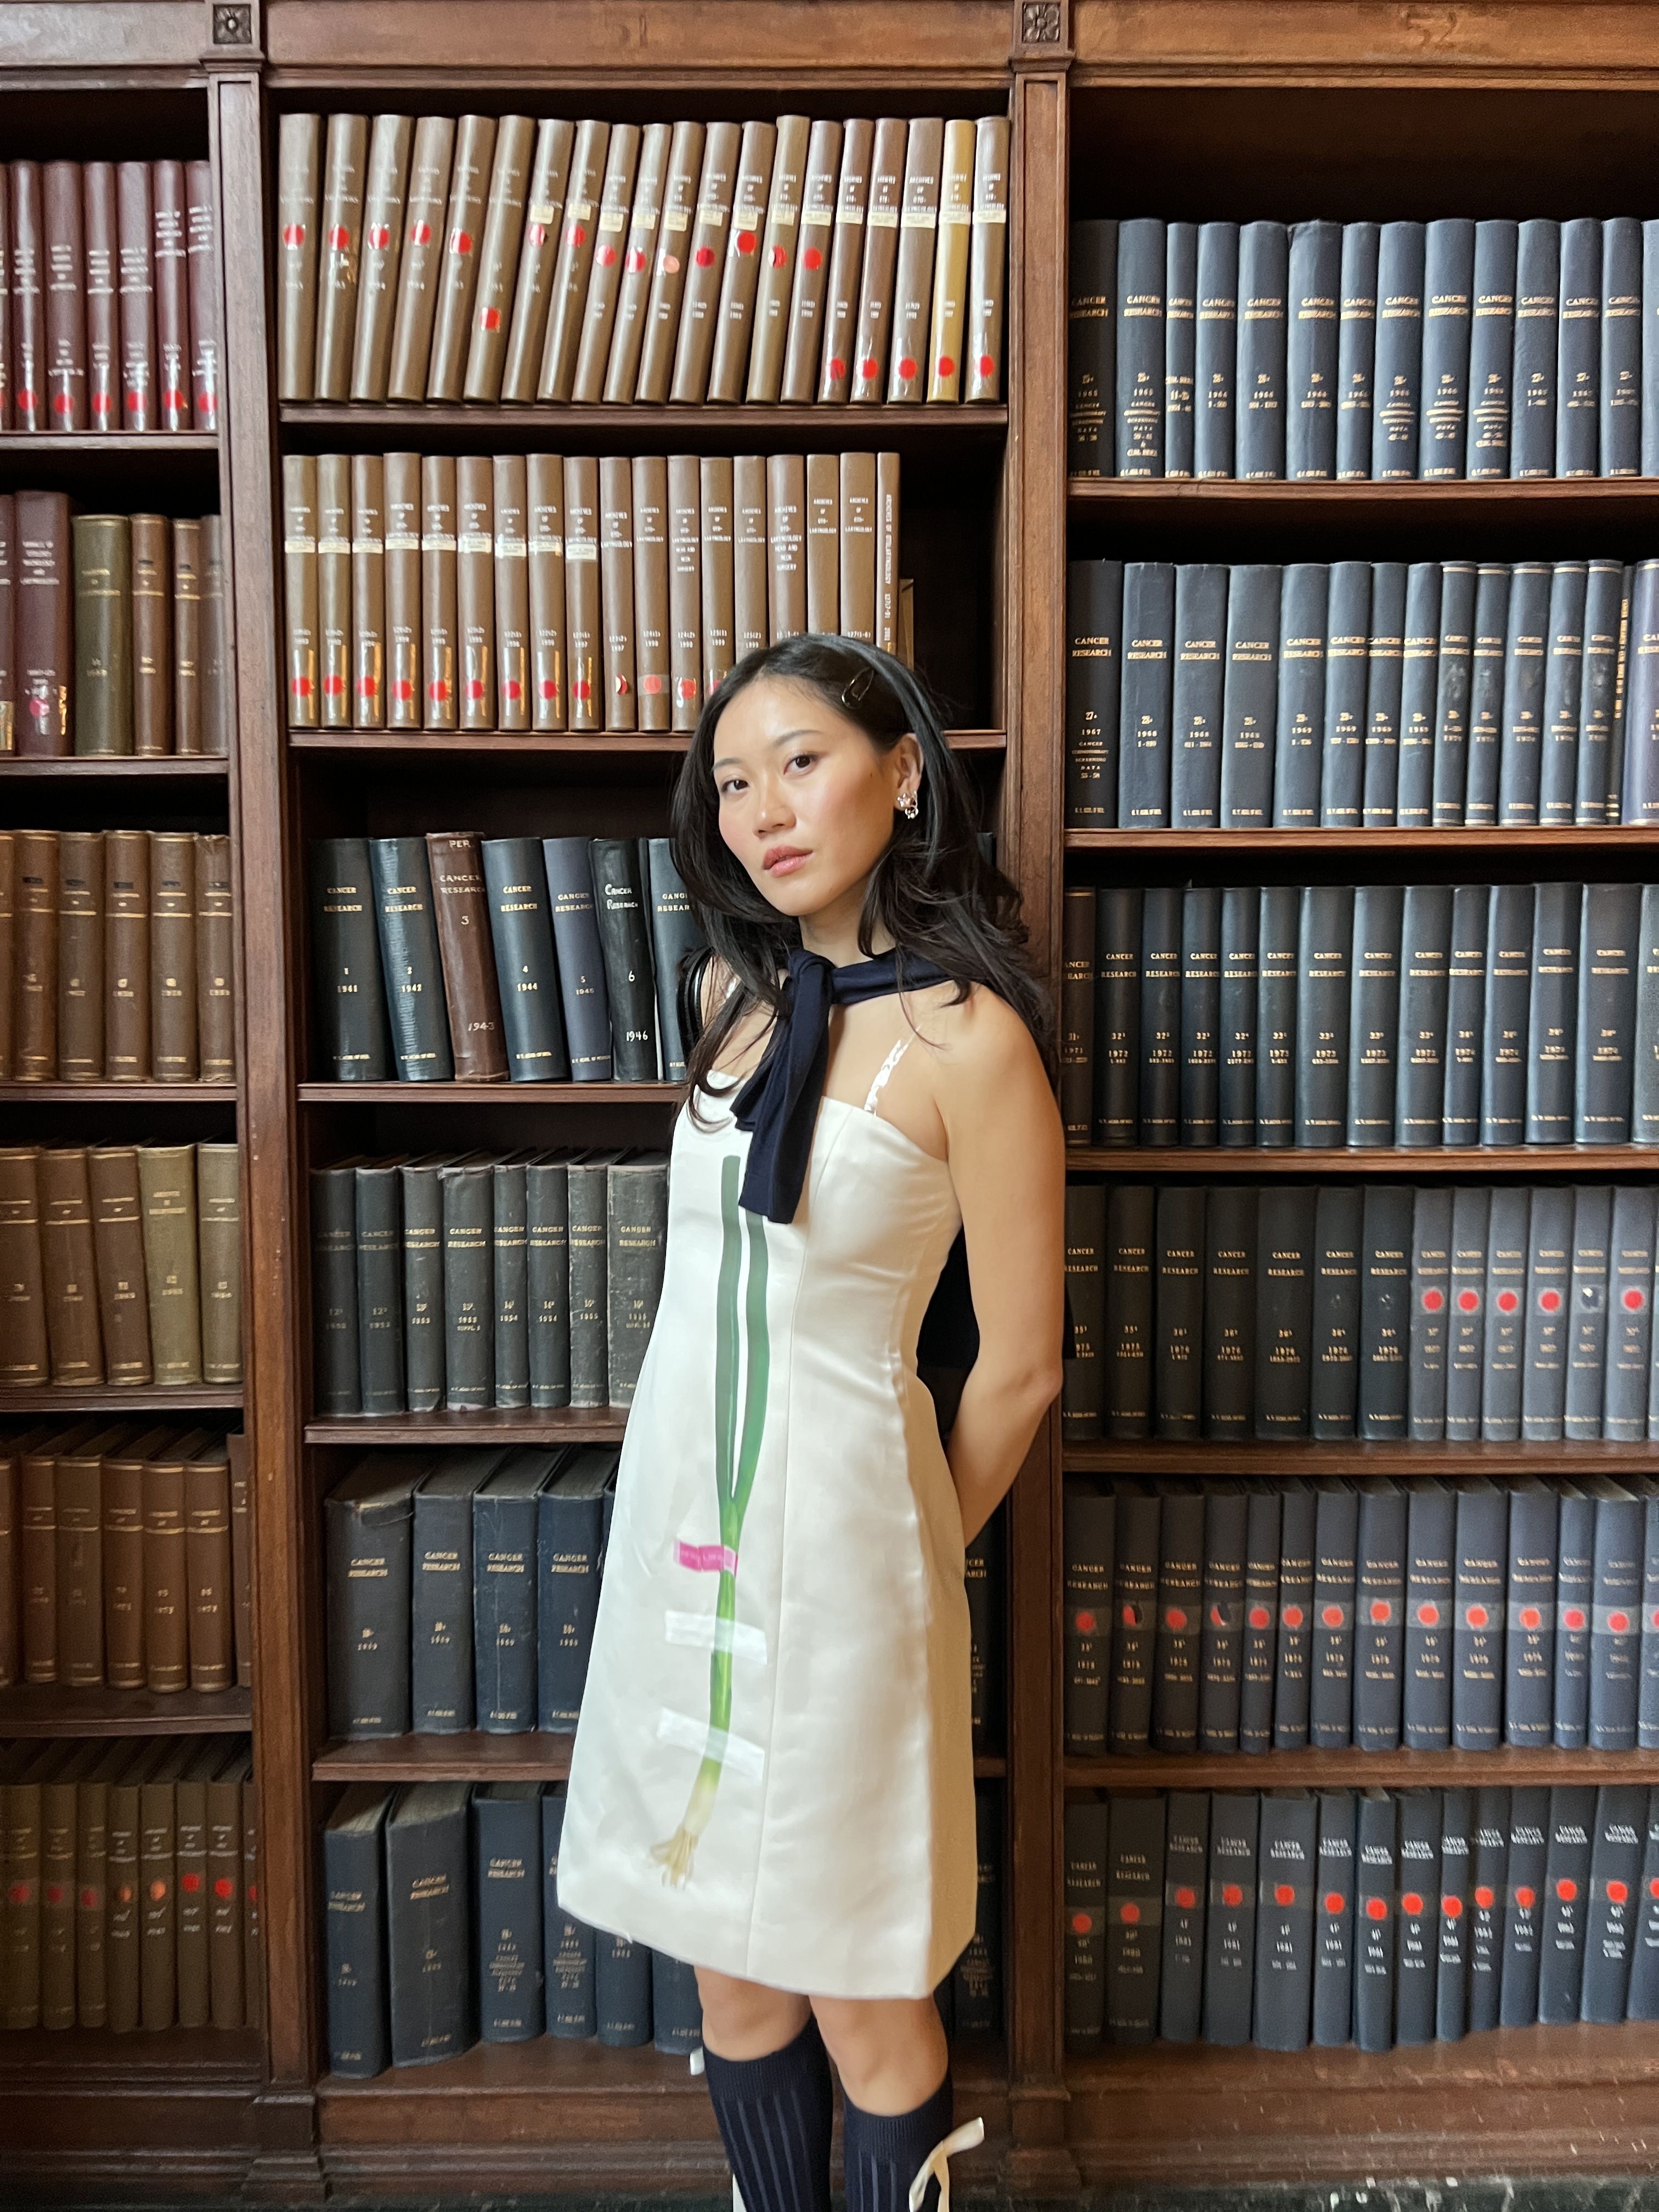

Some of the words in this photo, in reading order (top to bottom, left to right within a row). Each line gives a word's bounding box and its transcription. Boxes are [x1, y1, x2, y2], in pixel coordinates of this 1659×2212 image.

[909, 176, 934, 184] ARCHIVES
[1126, 296, 1160, 304] CANCER
[1247, 298, 1282, 307] CANCER
[1431, 295, 1466, 304] CANCER
[1075, 637, 1109, 645] CANCER
[1131, 639, 1163, 647] CANCER
[1185, 640, 1216, 648] CANCER
[1286, 637, 1322, 646] CANCER
[1330, 636, 1366, 645] CANCER
[1072, 649, 1111, 657] RESEARCH
[1127, 651, 1167, 659] RESEARCH
[1180, 652, 1220, 661] RESEARCH
[1232, 653, 1272, 661] RESEARCH
[387, 887, 416, 895] CANCER
[503, 885, 532, 894] CANCER
[557, 893, 589, 901] CANCER
[385, 904, 424, 913] RESEARCH
[501, 903, 538, 912] RESEARCH
[461, 916, 470, 926] 3
[522, 966, 529, 974] 4
[628, 970, 635, 982] 6
[401, 984, 422, 992] 1942
[517, 983, 538, 992] 1944
[468, 1022, 494, 1032] 1943
[626, 1031, 648, 1042] 1946
[1316, 1049, 1337, 1058] 1973
[572, 1225, 603, 1233] CANCER
[620, 1226, 652, 1234] CANCER
[447, 1240, 486, 1249] RESEARCH
[529, 1239, 567, 1247] RESEARCH
[1217, 1250, 1246, 1259] CANCER
[1272, 1251, 1301, 1260] CANCER
[1113, 1265, 1149, 1273] RESEARCH
[1162, 1267, 1199, 1275] RESEARCH
[1212, 1267, 1250, 1275] RESEARCH
[1267, 1268, 1305, 1277] RESEARCH
[488, 1553, 523, 1561] CANCER
[553, 1553, 588, 1562] CANCER
[1072, 1564, 1104, 1573] CANCER
